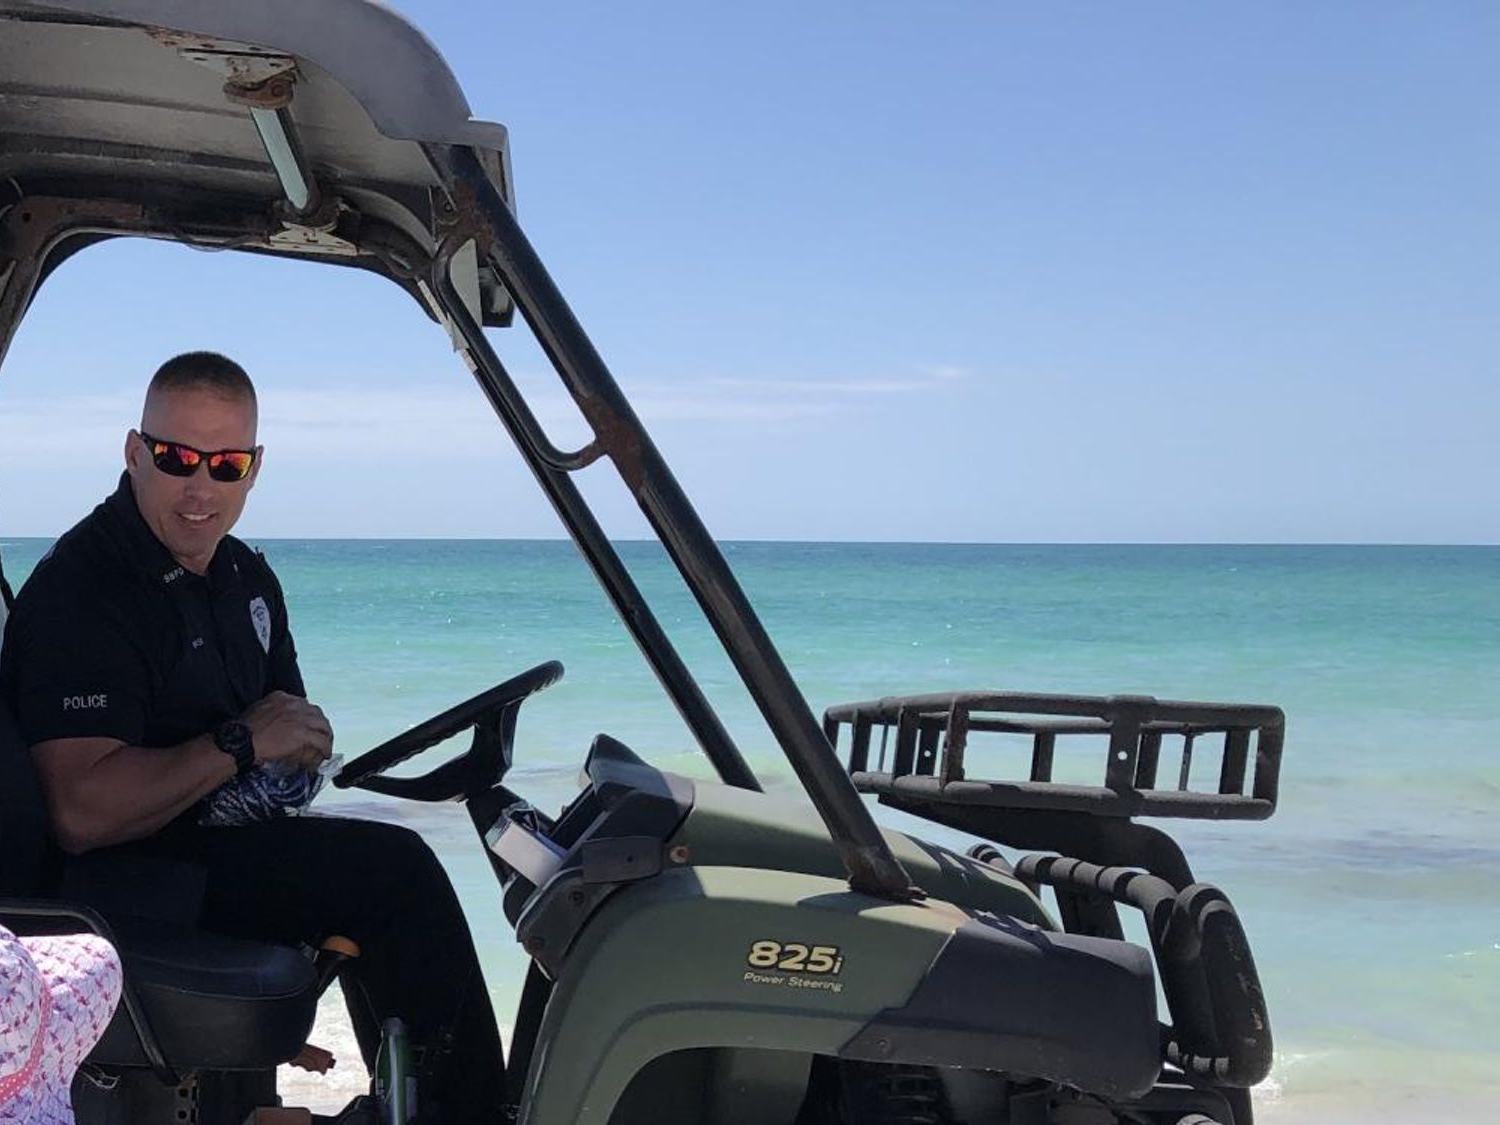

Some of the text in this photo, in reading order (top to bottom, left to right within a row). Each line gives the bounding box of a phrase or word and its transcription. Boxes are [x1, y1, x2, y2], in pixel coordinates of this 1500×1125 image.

[63, 694, 108, 710] POLICE
[748, 940, 843, 974] 825i
[744, 971, 843, 993] Power Steering
